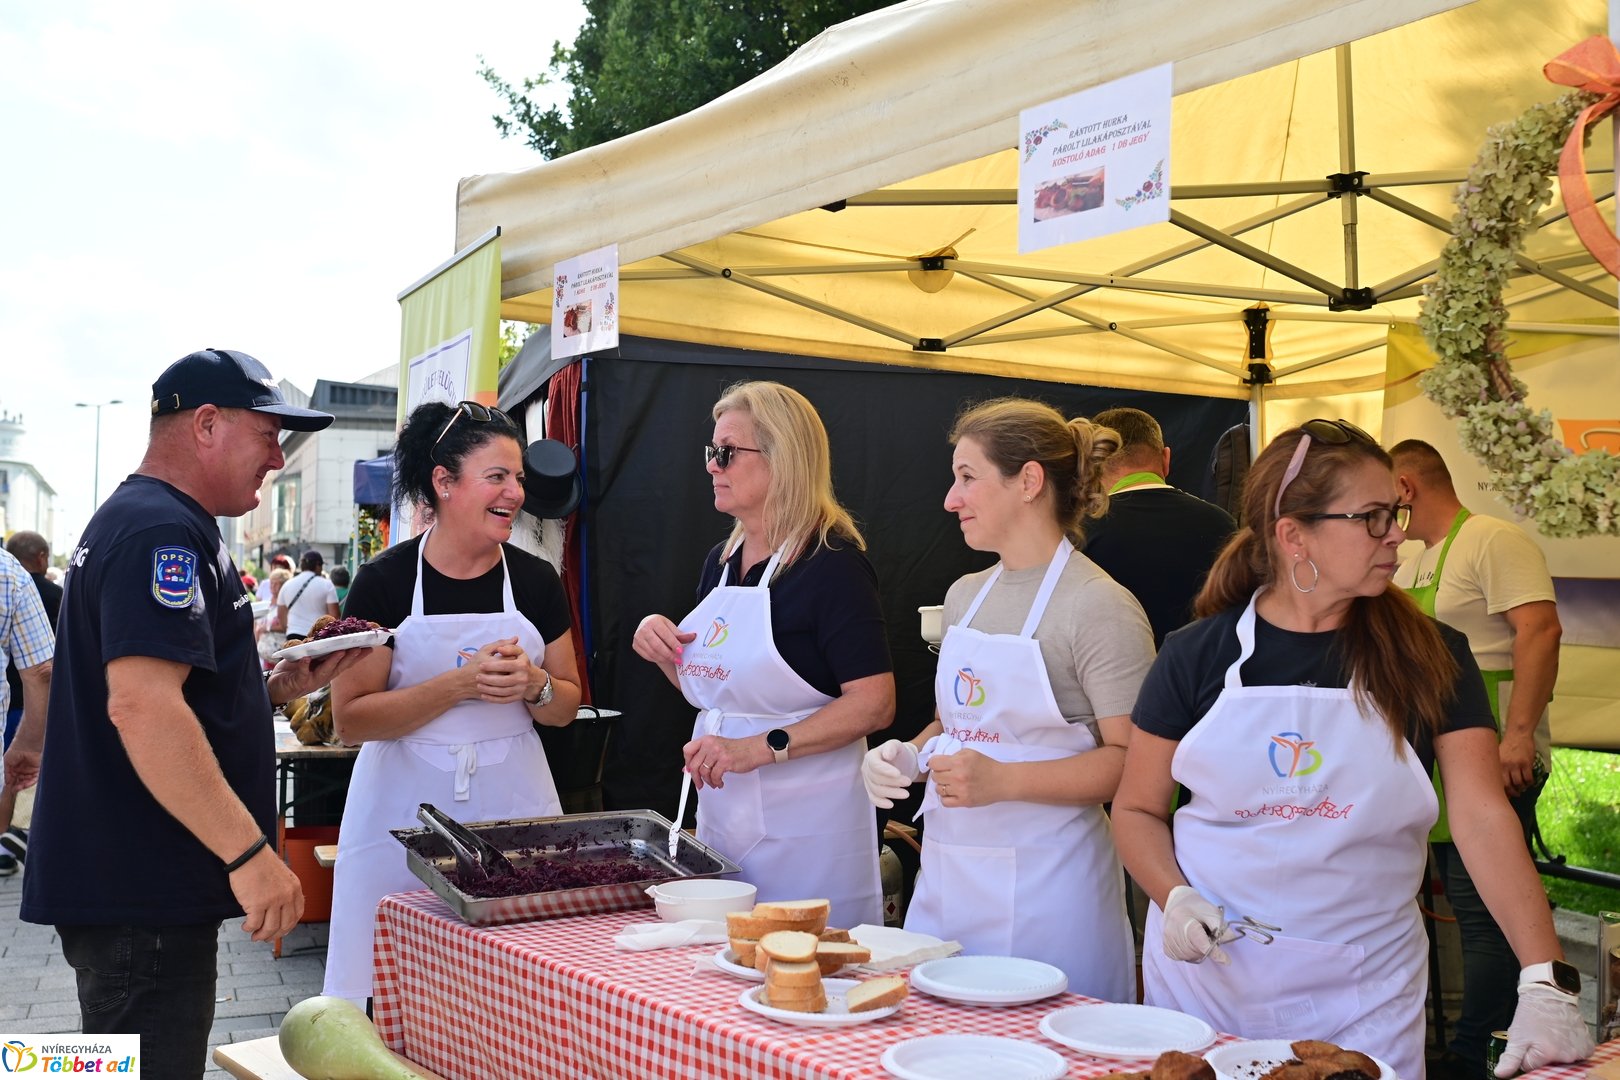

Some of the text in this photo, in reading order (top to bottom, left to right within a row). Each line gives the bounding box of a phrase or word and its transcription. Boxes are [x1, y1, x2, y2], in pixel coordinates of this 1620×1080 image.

[1052, 119, 1152, 156] PÁROLT LILAKÁPOSZTÁVAL
[1069, 114, 1128, 139] RÁNTOTT HURKA
[1052, 149, 1085, 168] KOSTOLÓ
[1085, 145, 1107, 158] ADAG
[1117, 139, 1128, 150] DB
[1129, 131, 1151, 146] JEGY
[160, 553, 192, 565] OPSZ
[1262, 784, 1329, 796] NYÍREGYHÁZA
